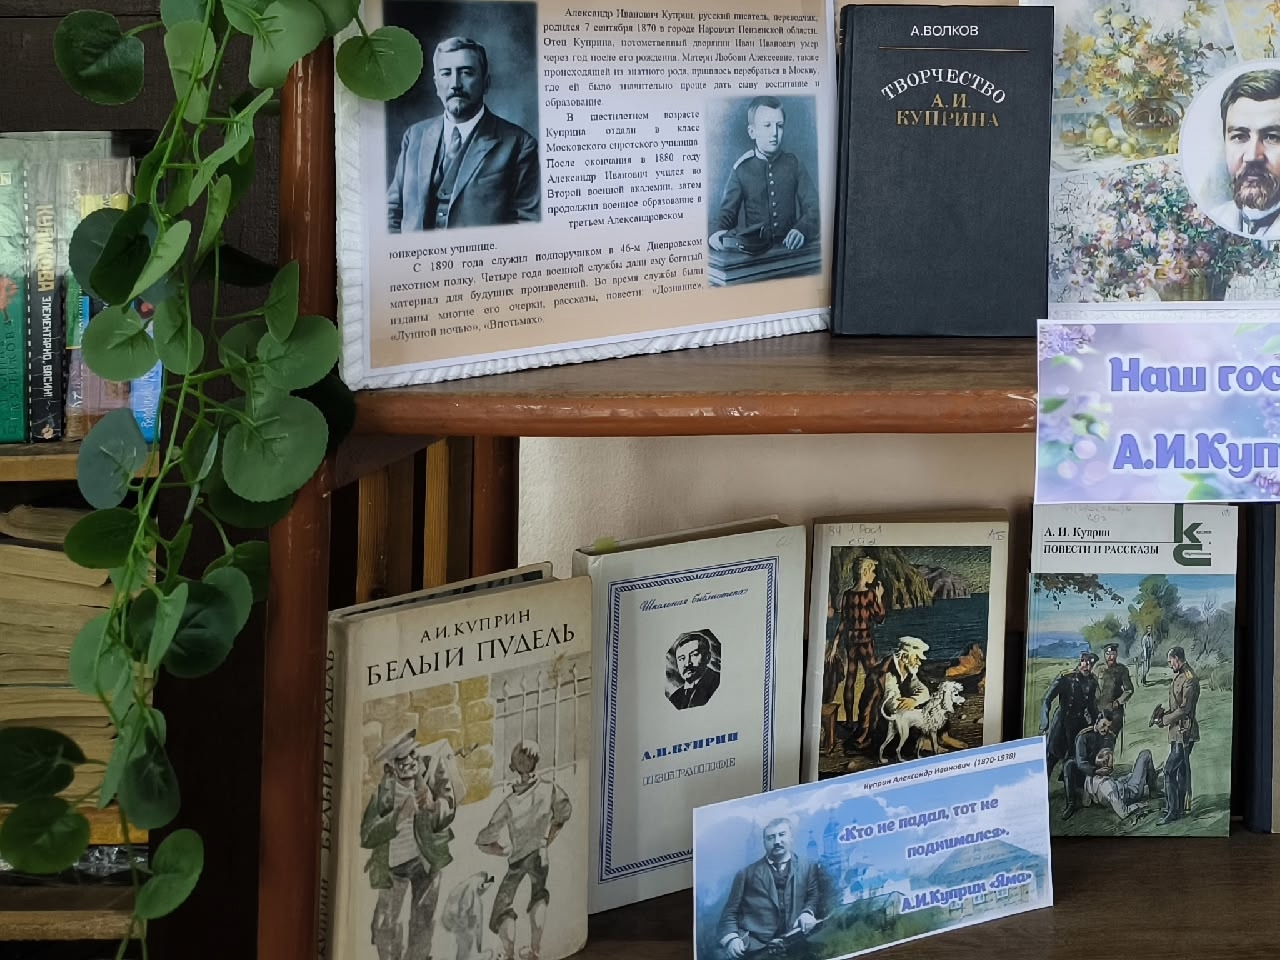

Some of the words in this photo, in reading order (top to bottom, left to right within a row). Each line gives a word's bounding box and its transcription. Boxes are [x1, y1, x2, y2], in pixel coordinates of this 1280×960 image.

[585, 23, 589, 31] 7
[594, 24, 633, 33] сентября
[637, 24, 656, 32] 1870
[668, 26, 695, 34] городе
[911, 25, 979, 36] А.ВОЛКОВ
[881, 68, 1006, 103] ТВОРЧЕСТВО
[897, 111, 999, 127] КУПРИНА
[546, 128, 586, 138] Куприна
[606, 127, 636, 135] отдали
[547, 158, 575, 168] После
[655, 153, 673, 162] 1880
[683, 154, 700, 162] году
[548, 173, 596, 183] Александр
[605, 170, 647, 180] Иванович
[413, 263, 421, 273] С
[430, 260, 454, 271] 1890
[462, 258, 484, 268] года
[492, 254, 528, 266] служил
[1109, 357, 1206, 392] Наш
[1073, 528, 1110, 539] Куприн
[1044, 545, 1091, 554] ПОВЕСТИ
[1105, 545, 1158, 554] РАССКАЗЫ
[367, 646, 464, 686] БЕЛЫЙ
[477, 624, 575, 661] ПУДЕЛЬ
[643, 758, 735, 786] ИЗБРАННОЕ
[893, 770, 933, 783] Александр
[935, 762, 970, 774] Иванович
[838, 822, 874, 843] «Кто
[878, 819, 895, 833] не
[899, 809, 949, 830] падал,
[953, 803, 977, 817] тот
[981, 797, 999, 812] не
[907, 826, 1010, 859] поднимался».
[901, 883, 986, 912] А.И.Куприн
[989, 870, 1032, 889] «Яма»
